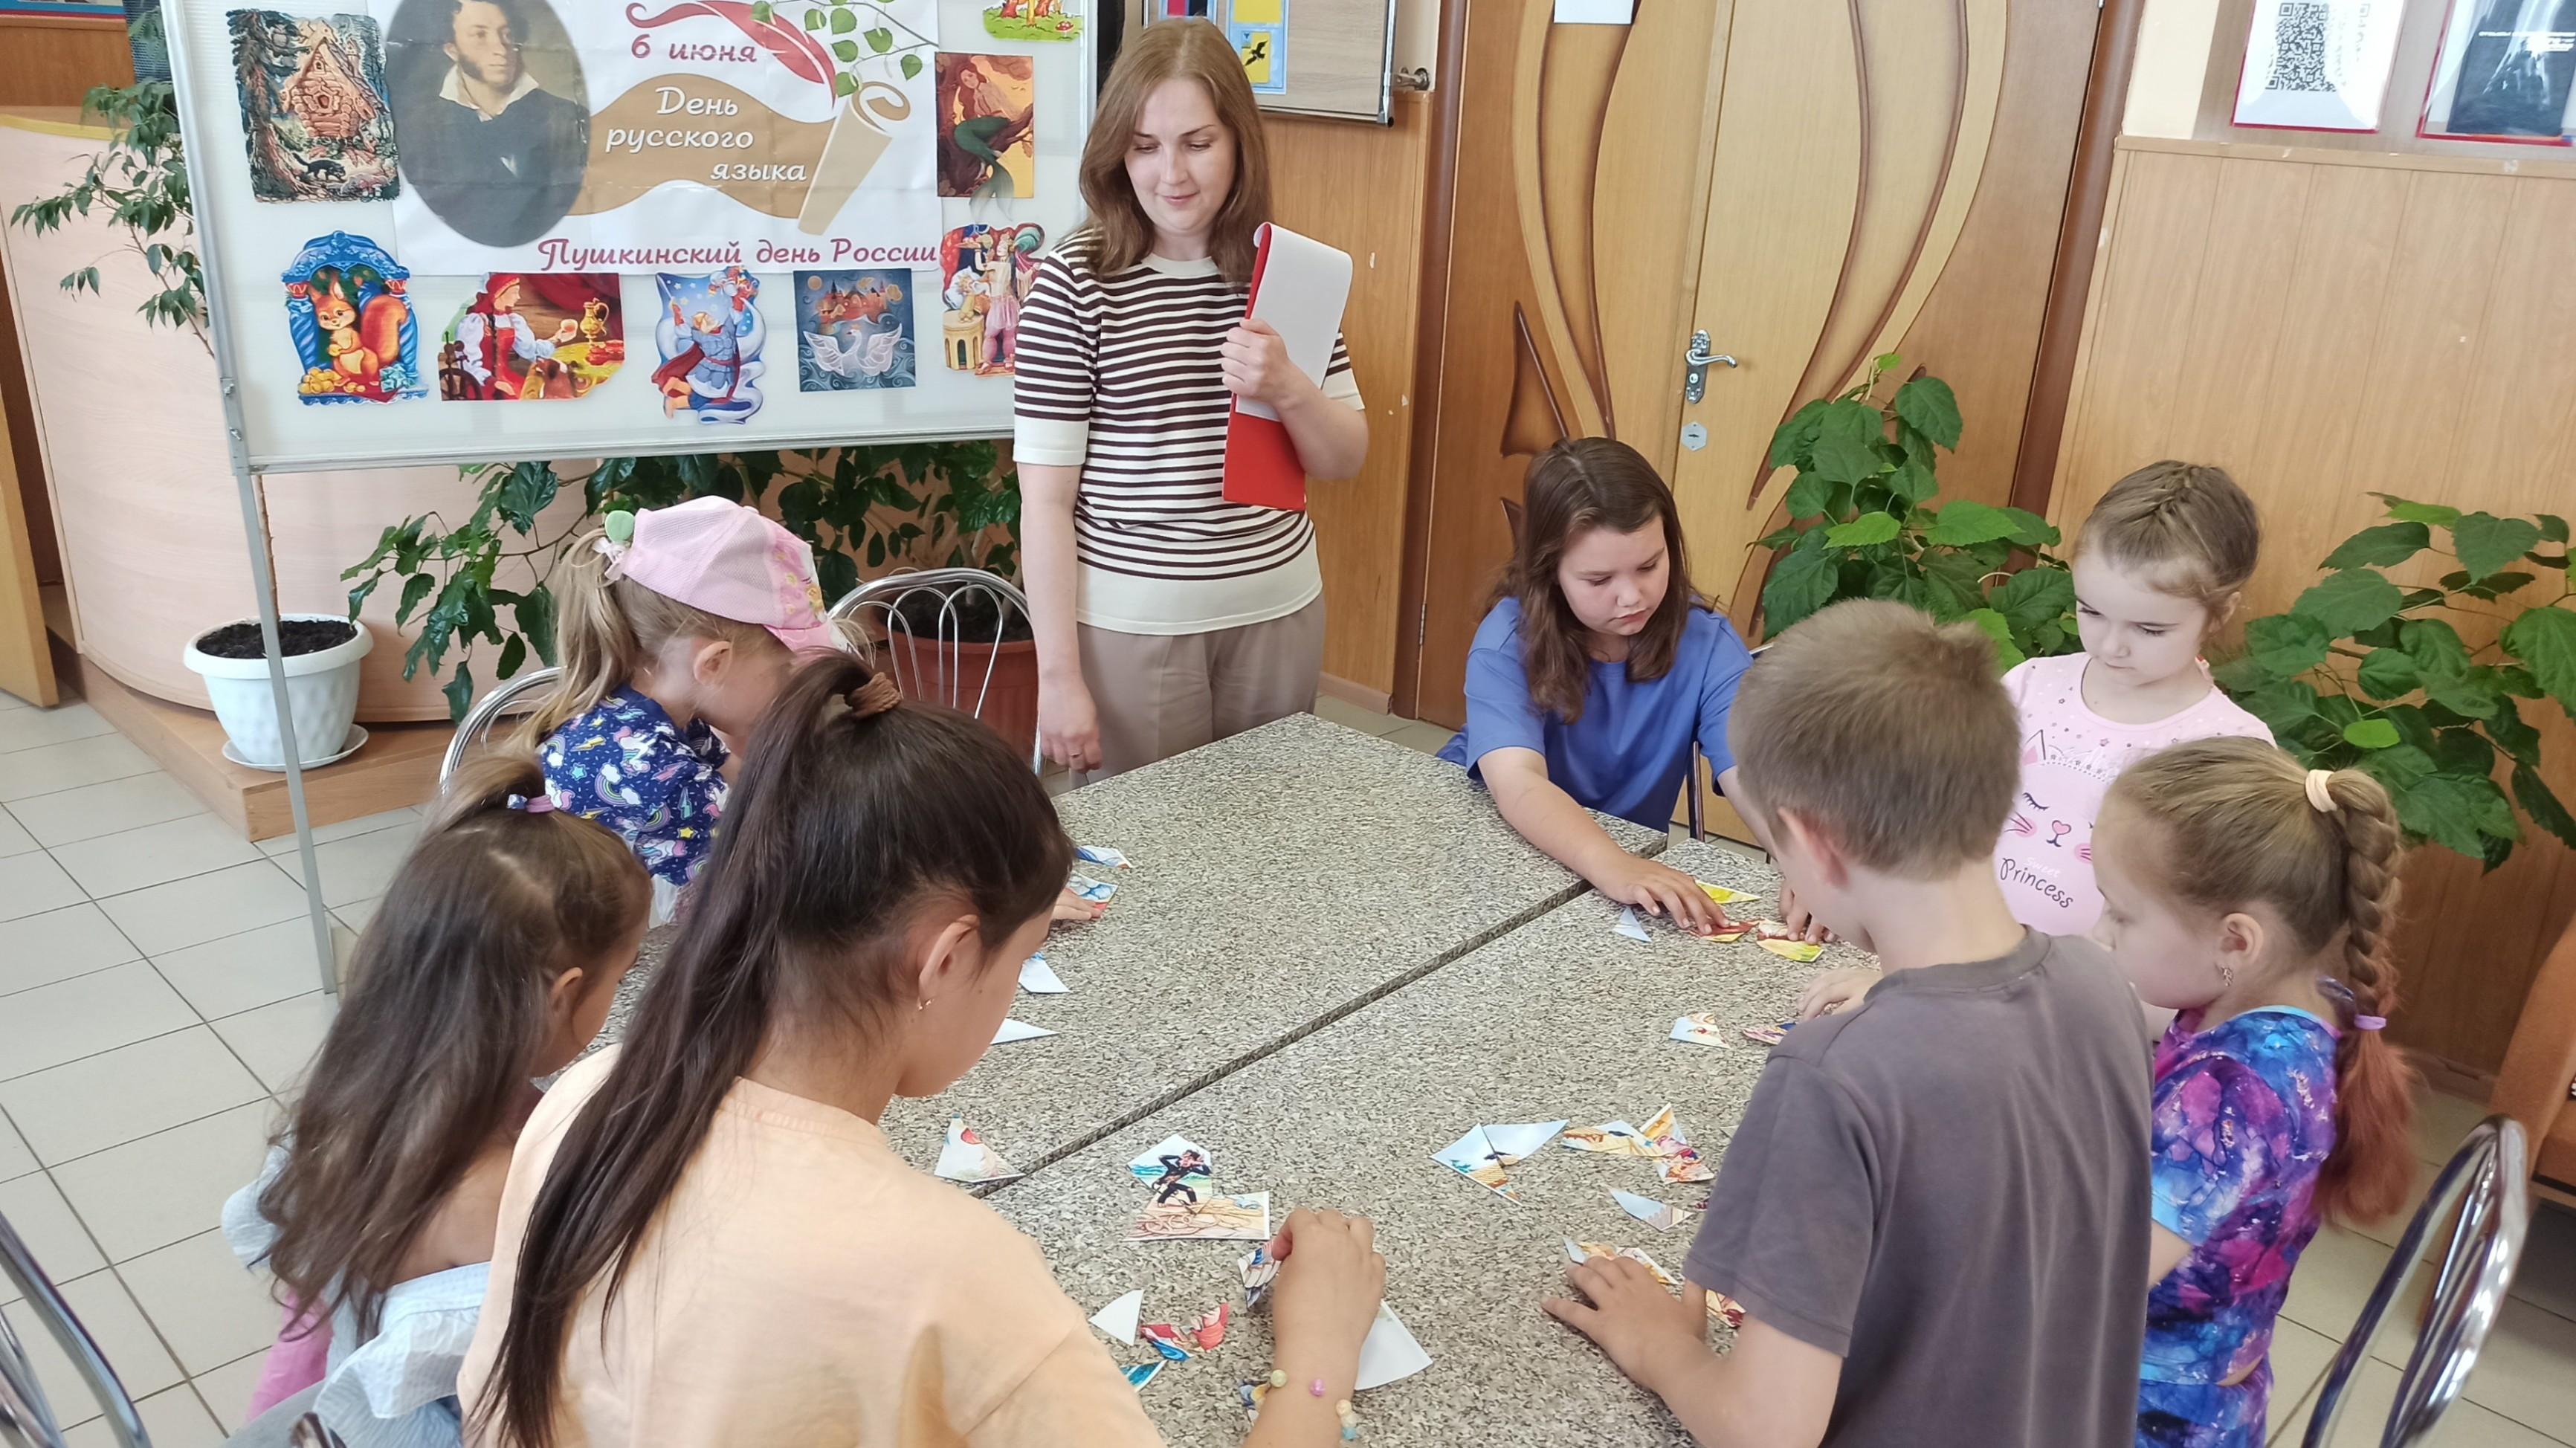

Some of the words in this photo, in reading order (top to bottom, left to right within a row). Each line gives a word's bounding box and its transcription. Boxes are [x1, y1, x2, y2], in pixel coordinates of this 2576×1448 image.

[631, 33, 651, 59] 6
[669, 42, 757, 62] июня
[655, 85, 738, 116] День
[604, 127, 754, 154] русского
[710, 162, 807, 182] языка
[537, 238, 742, 271] Пушкинский
[755, 239, 820, 262] день
[830, 237, 937, 262] России
[2000, 857, 2074, 908] Princess
